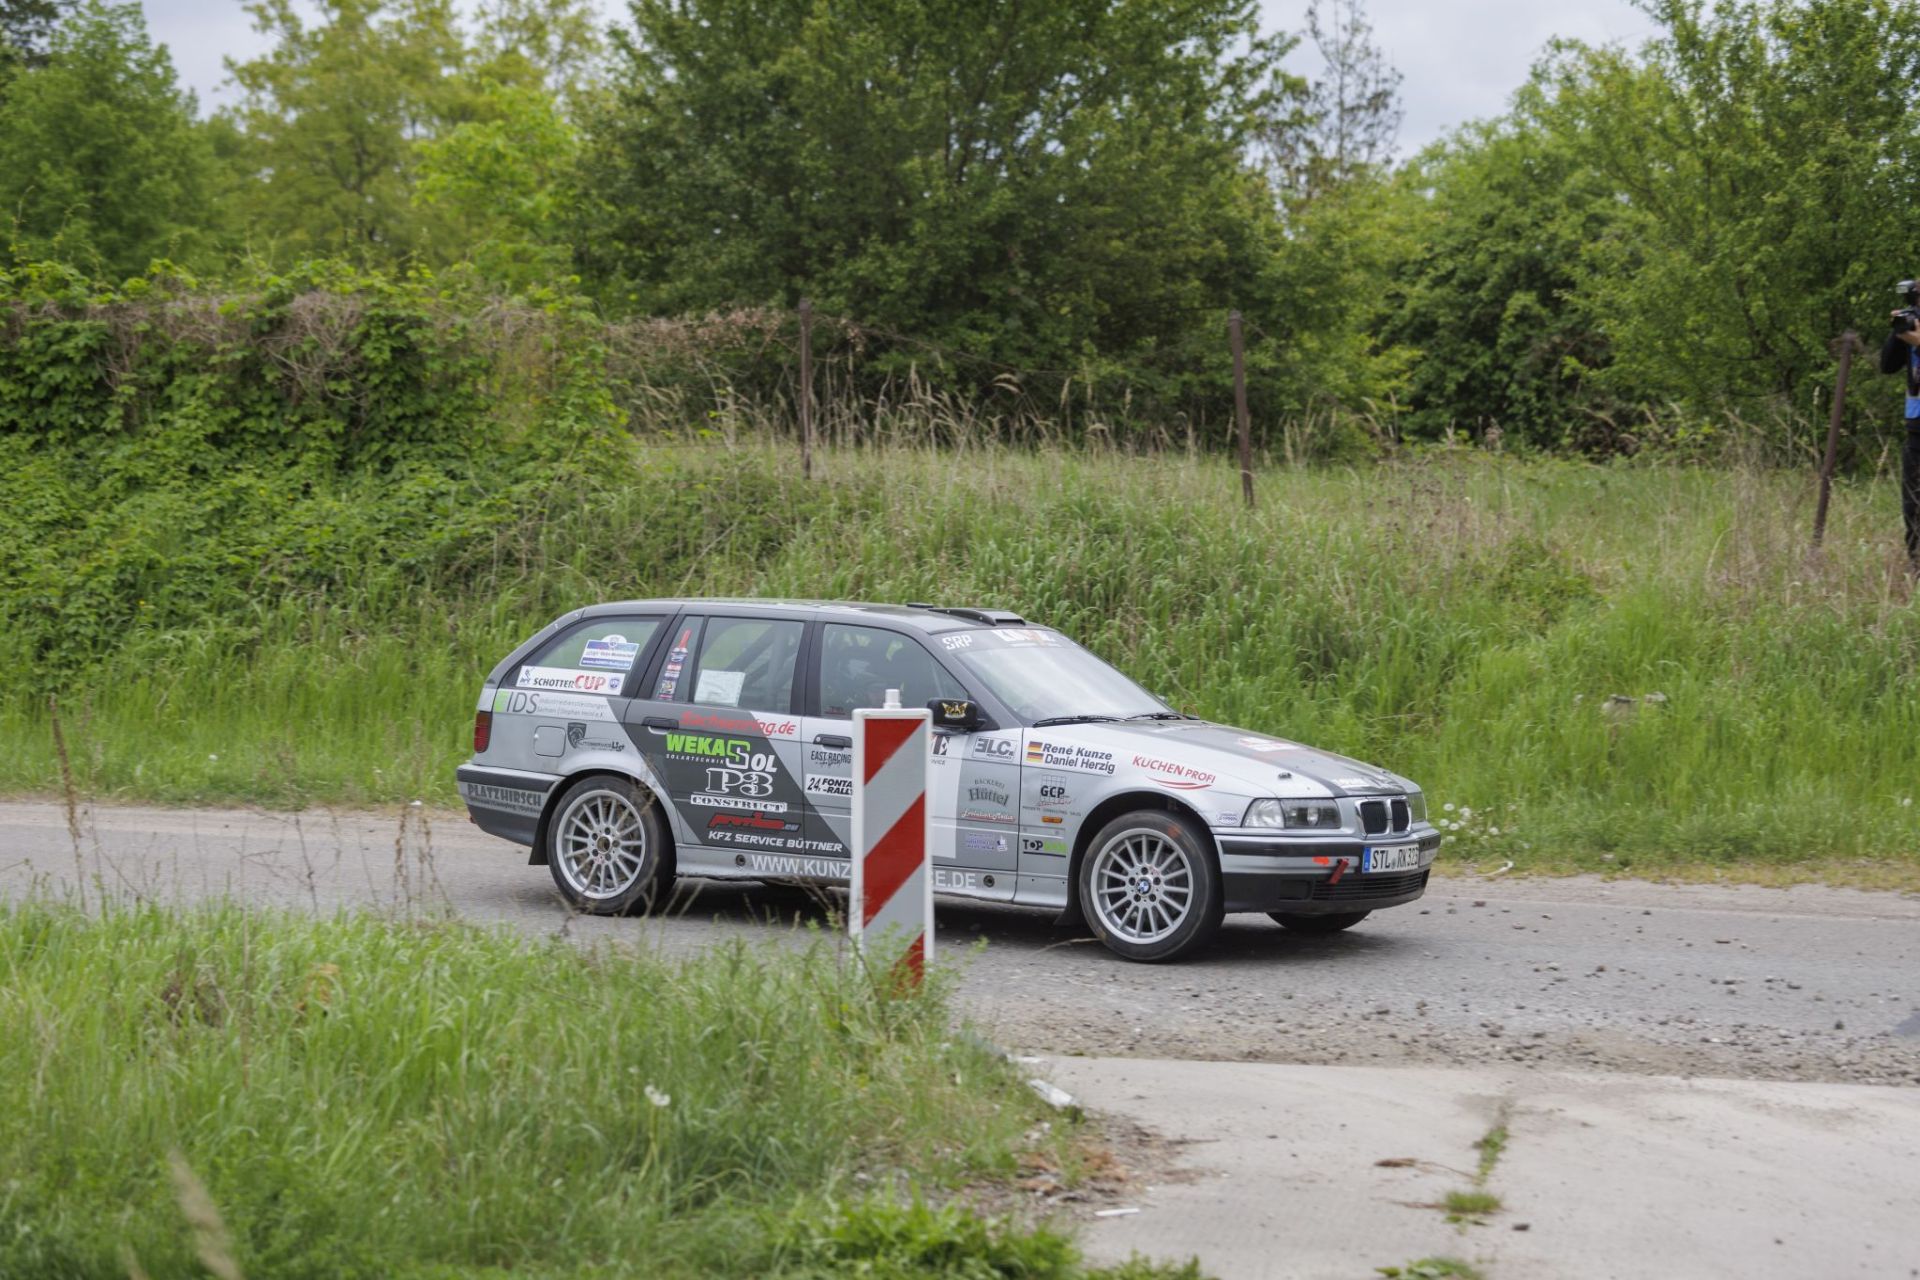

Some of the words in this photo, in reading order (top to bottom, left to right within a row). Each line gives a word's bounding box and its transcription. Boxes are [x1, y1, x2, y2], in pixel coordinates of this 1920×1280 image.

[942, 635, 973, 650] SRP
[506, 691, 540, 714] IDS
[811, 751, 827, 761] EAST
[1043, 743, 1074, 755] René
[1076, 747, 1113, 760] Kunze
[1045, 754, 1078, 767] Daniel
[1080, 758, 1115, 774] Herzig
[1185, 769, 1216, 783] PROFI
[467, 783, 542, 807] PLATZHIRSCH
[1041, 785, 1065, 798] GCP
[692, 796, 786, 812] CONSTRUCT
[708, 831, 735, 842] KFZ
[735, 834, 785, 847] SERVICE
[787, 838, 843, 852] BÜTTNER
[1372, 849, 1391, 869] STL
